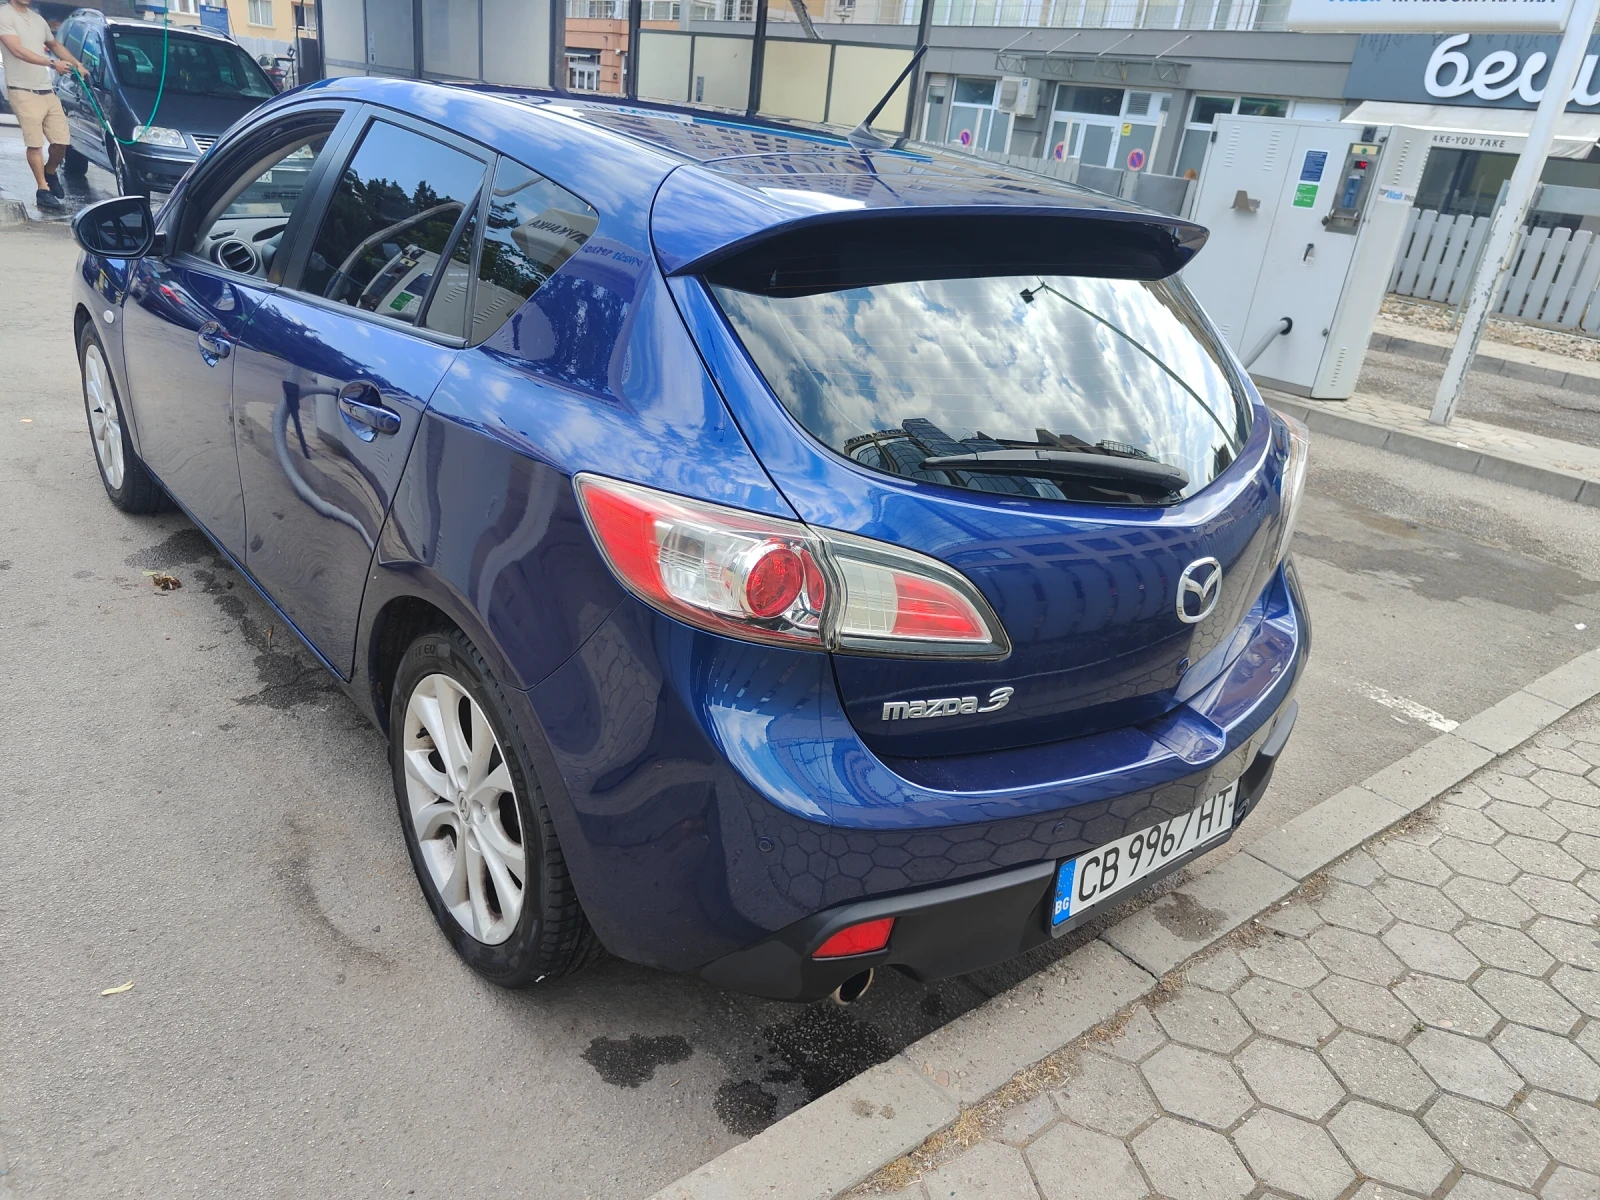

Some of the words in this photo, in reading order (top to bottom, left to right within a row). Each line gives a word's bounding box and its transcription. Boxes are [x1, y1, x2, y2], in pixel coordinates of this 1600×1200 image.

[1480, 138, 1506, 148] TAKE
[977, 686, 1015, 713] 3
[1078, 846, 1120, 902] CB
[1196, 786, 1233, 840] HT
[1055, 896, 1070, 915] BG
